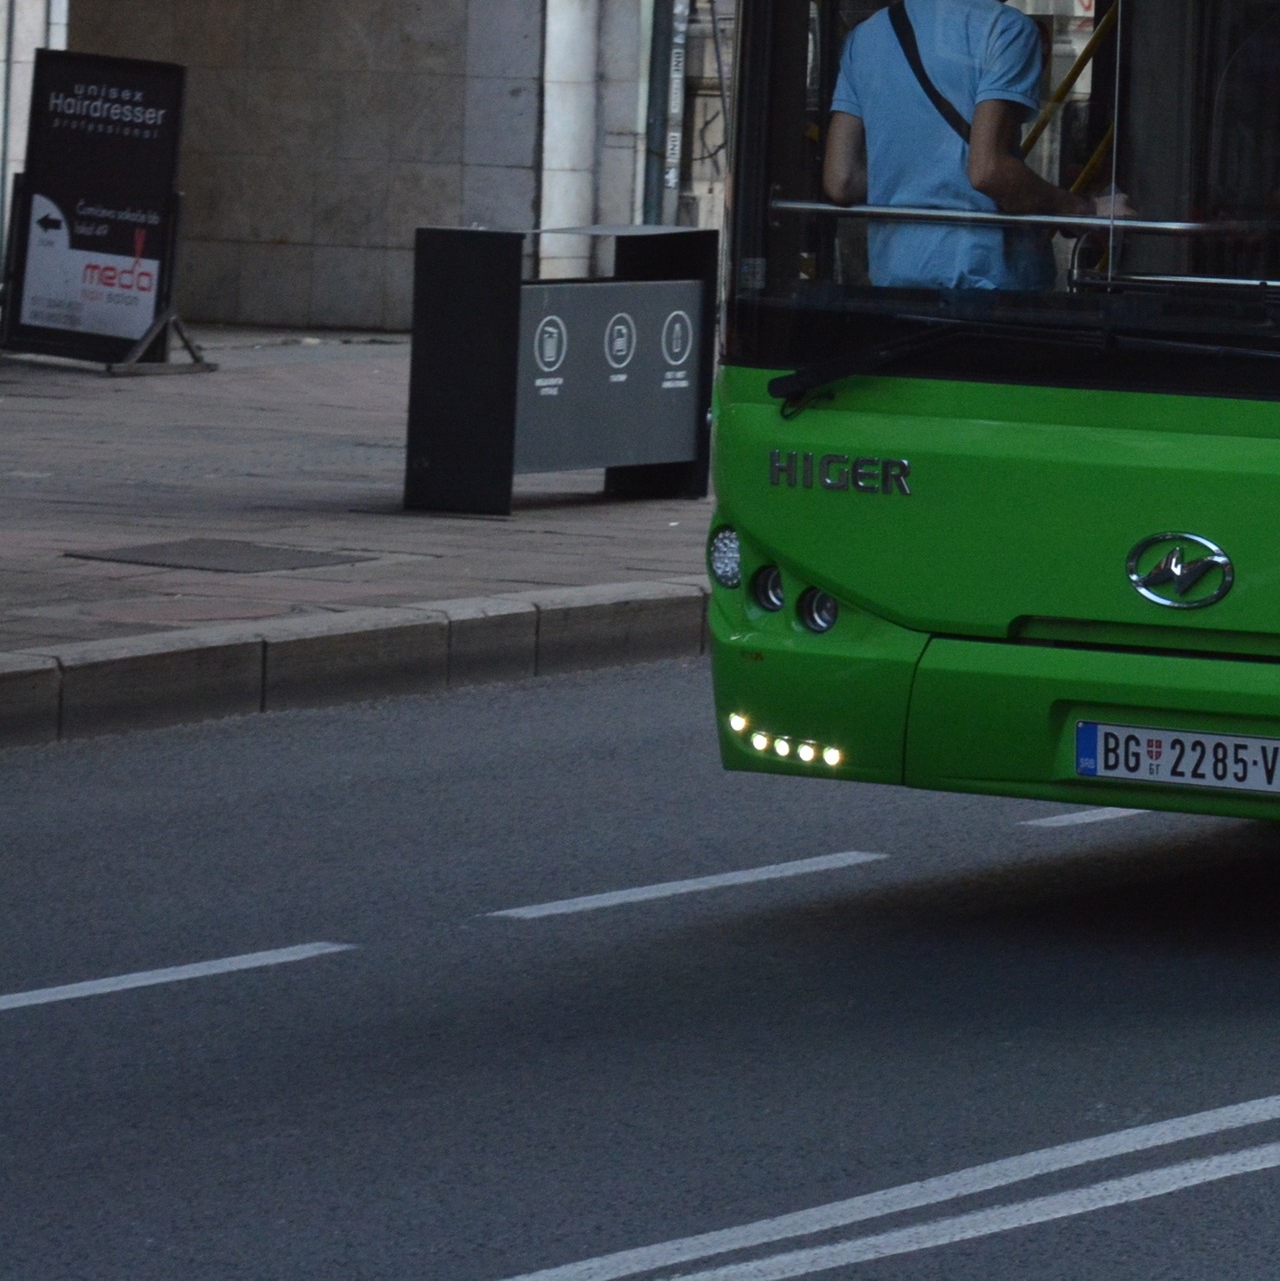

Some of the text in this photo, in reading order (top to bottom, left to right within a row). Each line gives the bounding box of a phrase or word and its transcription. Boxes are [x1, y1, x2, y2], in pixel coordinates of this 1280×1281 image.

[48, 91, 166, 125] Hairdresser
[74, 83, 144, 102] unisex
[768, 449, 912, 495] HIGER
[1079, 757, 1095, 769] SRB
[1103, 731, 1141, 773] BG
